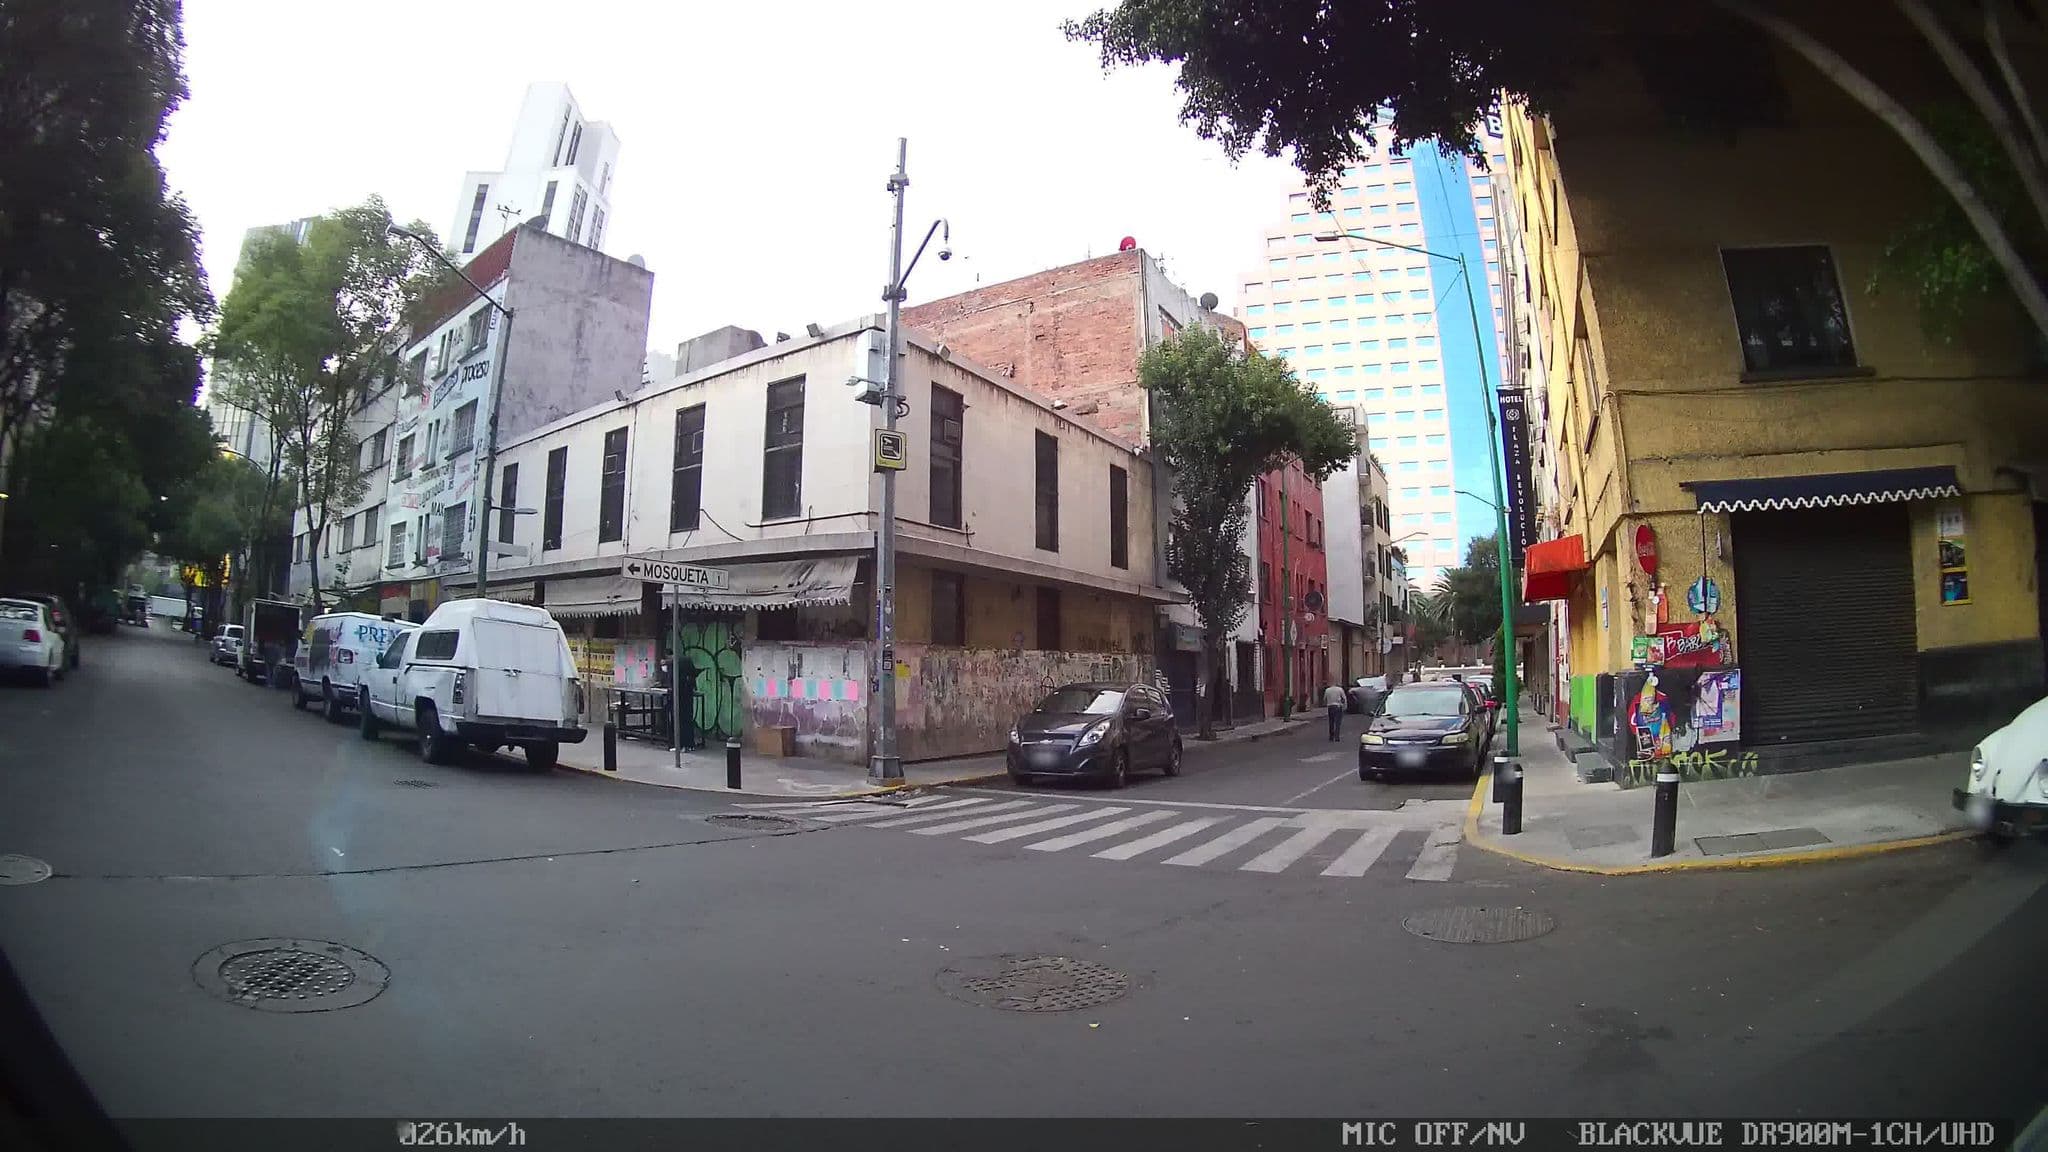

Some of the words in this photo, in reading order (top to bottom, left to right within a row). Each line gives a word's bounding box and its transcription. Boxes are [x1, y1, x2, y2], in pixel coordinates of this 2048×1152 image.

[460, 360, 490, 390] proceso
[1499, 395, 1524, 404] HOTEL
[643, 563, 709, 585] MOSQUETA
